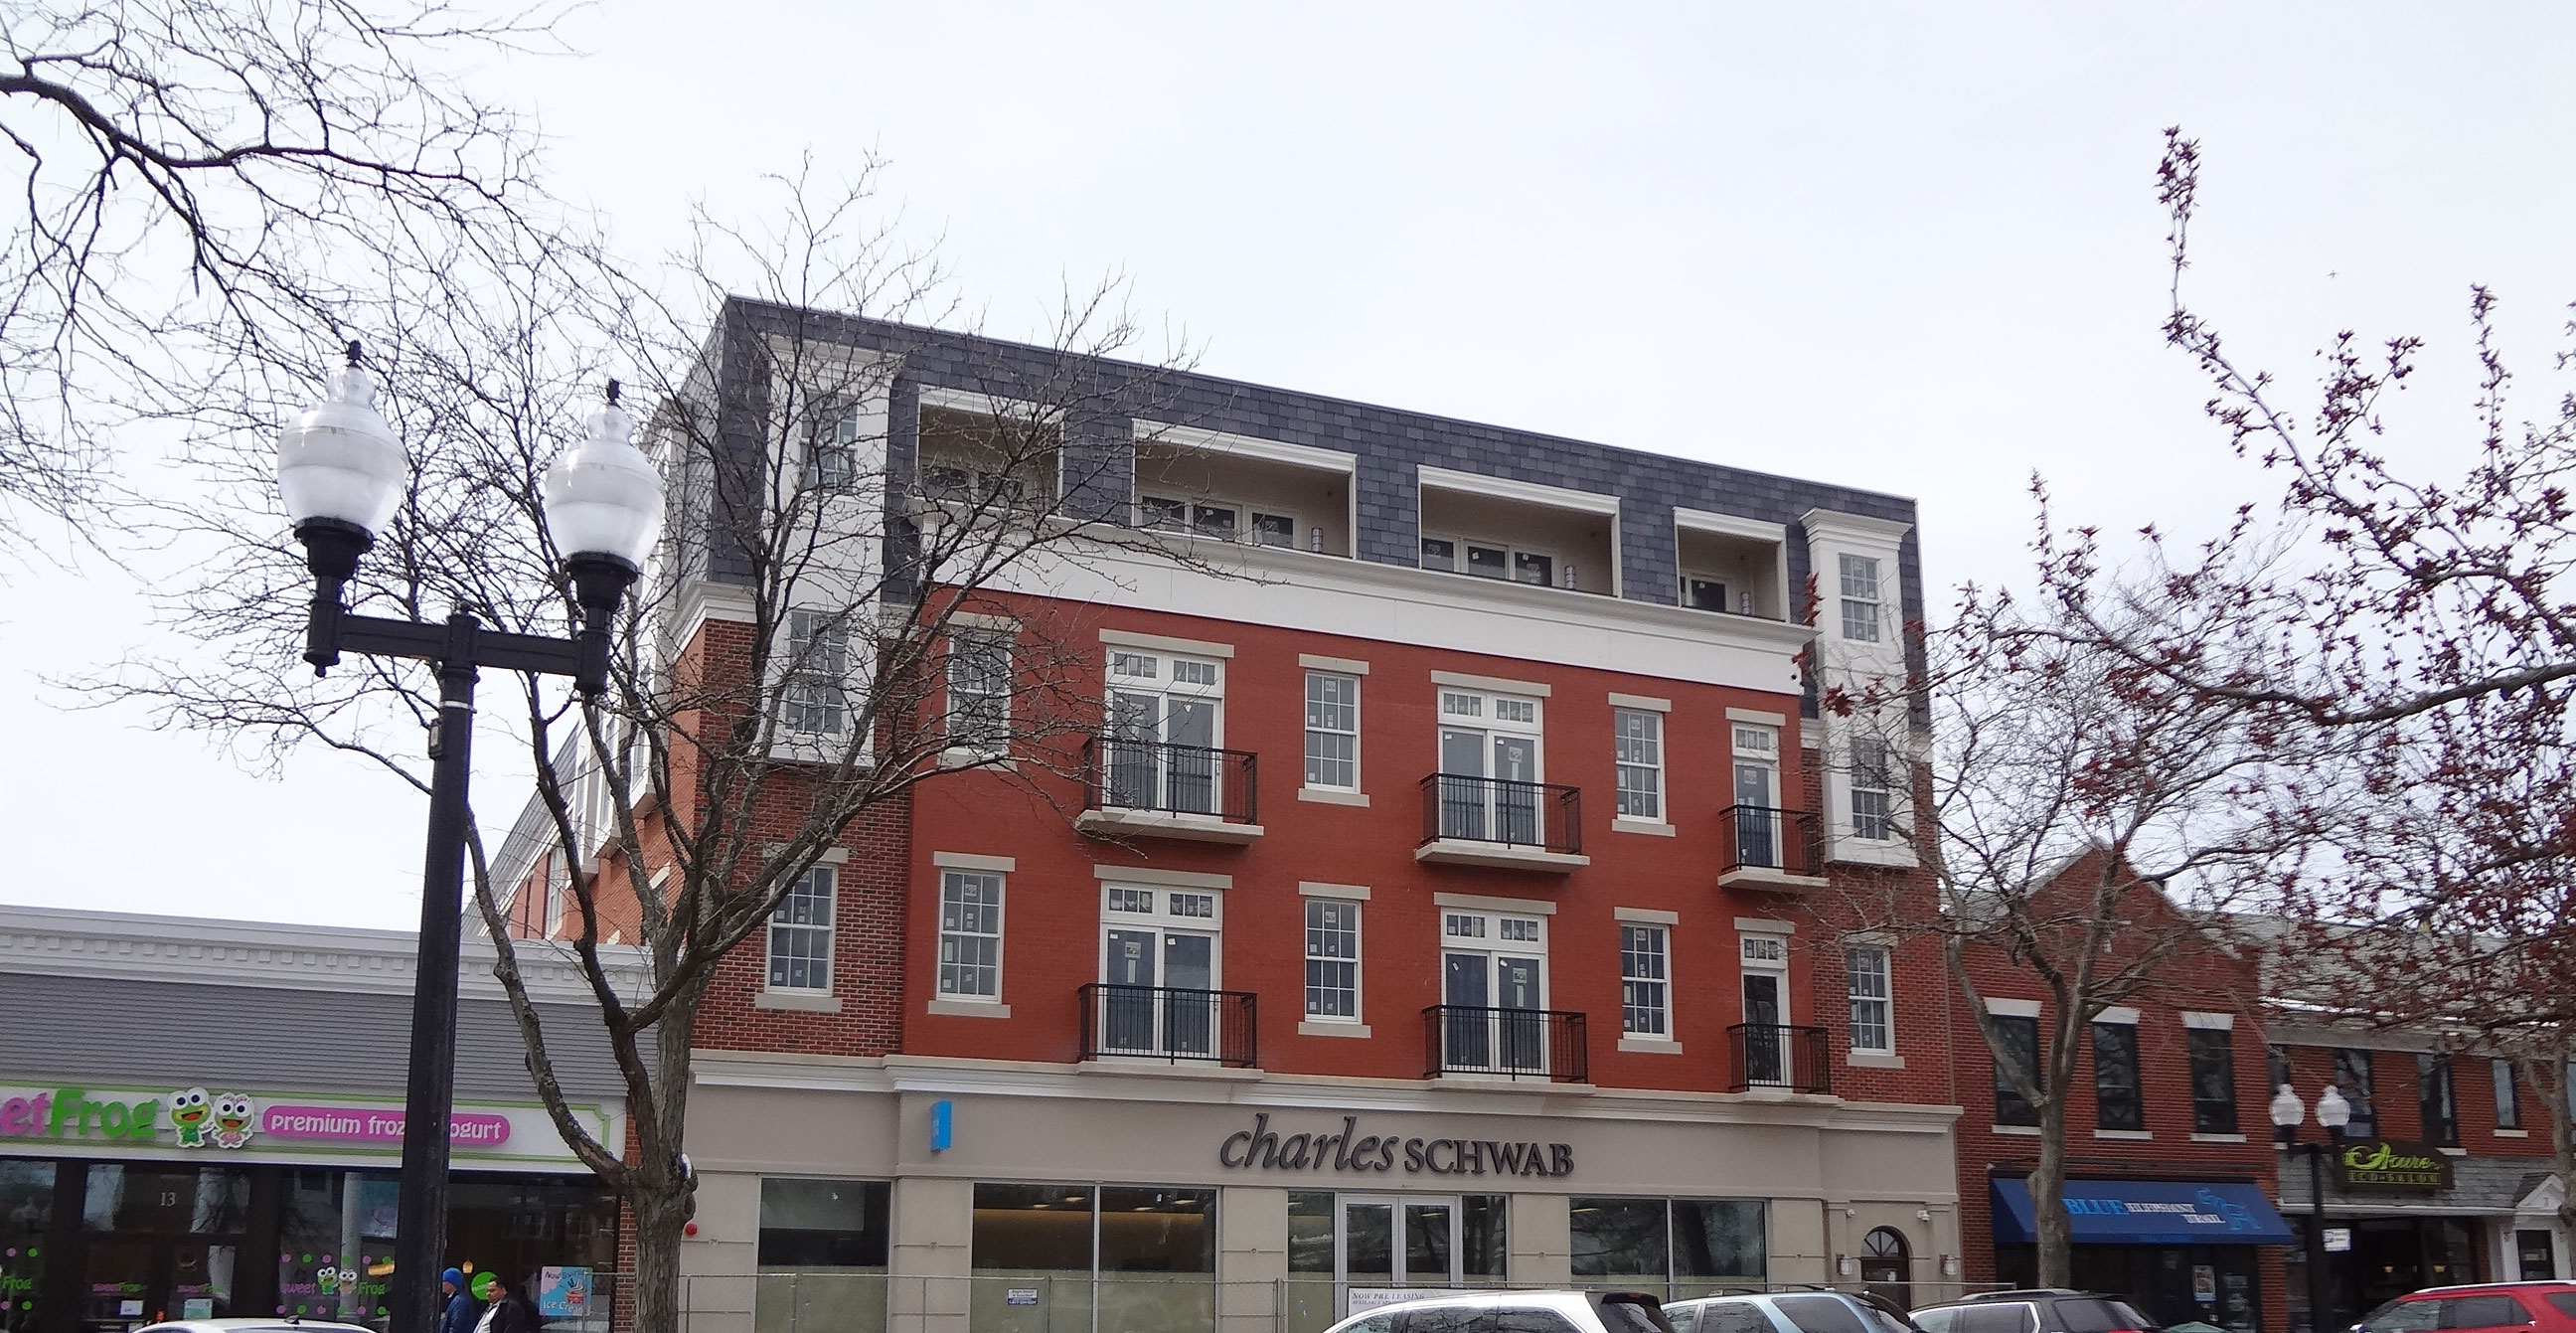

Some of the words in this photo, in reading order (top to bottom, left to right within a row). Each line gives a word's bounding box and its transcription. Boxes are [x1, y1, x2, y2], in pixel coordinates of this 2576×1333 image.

[270, 1113, 361, 1134] premium
[368, 1114, 406, 1135] froz
[449, 1120, 502, 1140] ogurt
[1220, 1112, 1399, 1171] charles
[1403, 1137, 1575, 1176] SCHWAB
[159, 1192, 177, 1207] 13
[2061, 1198, 2129, 1216] BLUE
[358, 1281, 386, 1295] Frog
[543, 1299, 557, 1309] Ice
